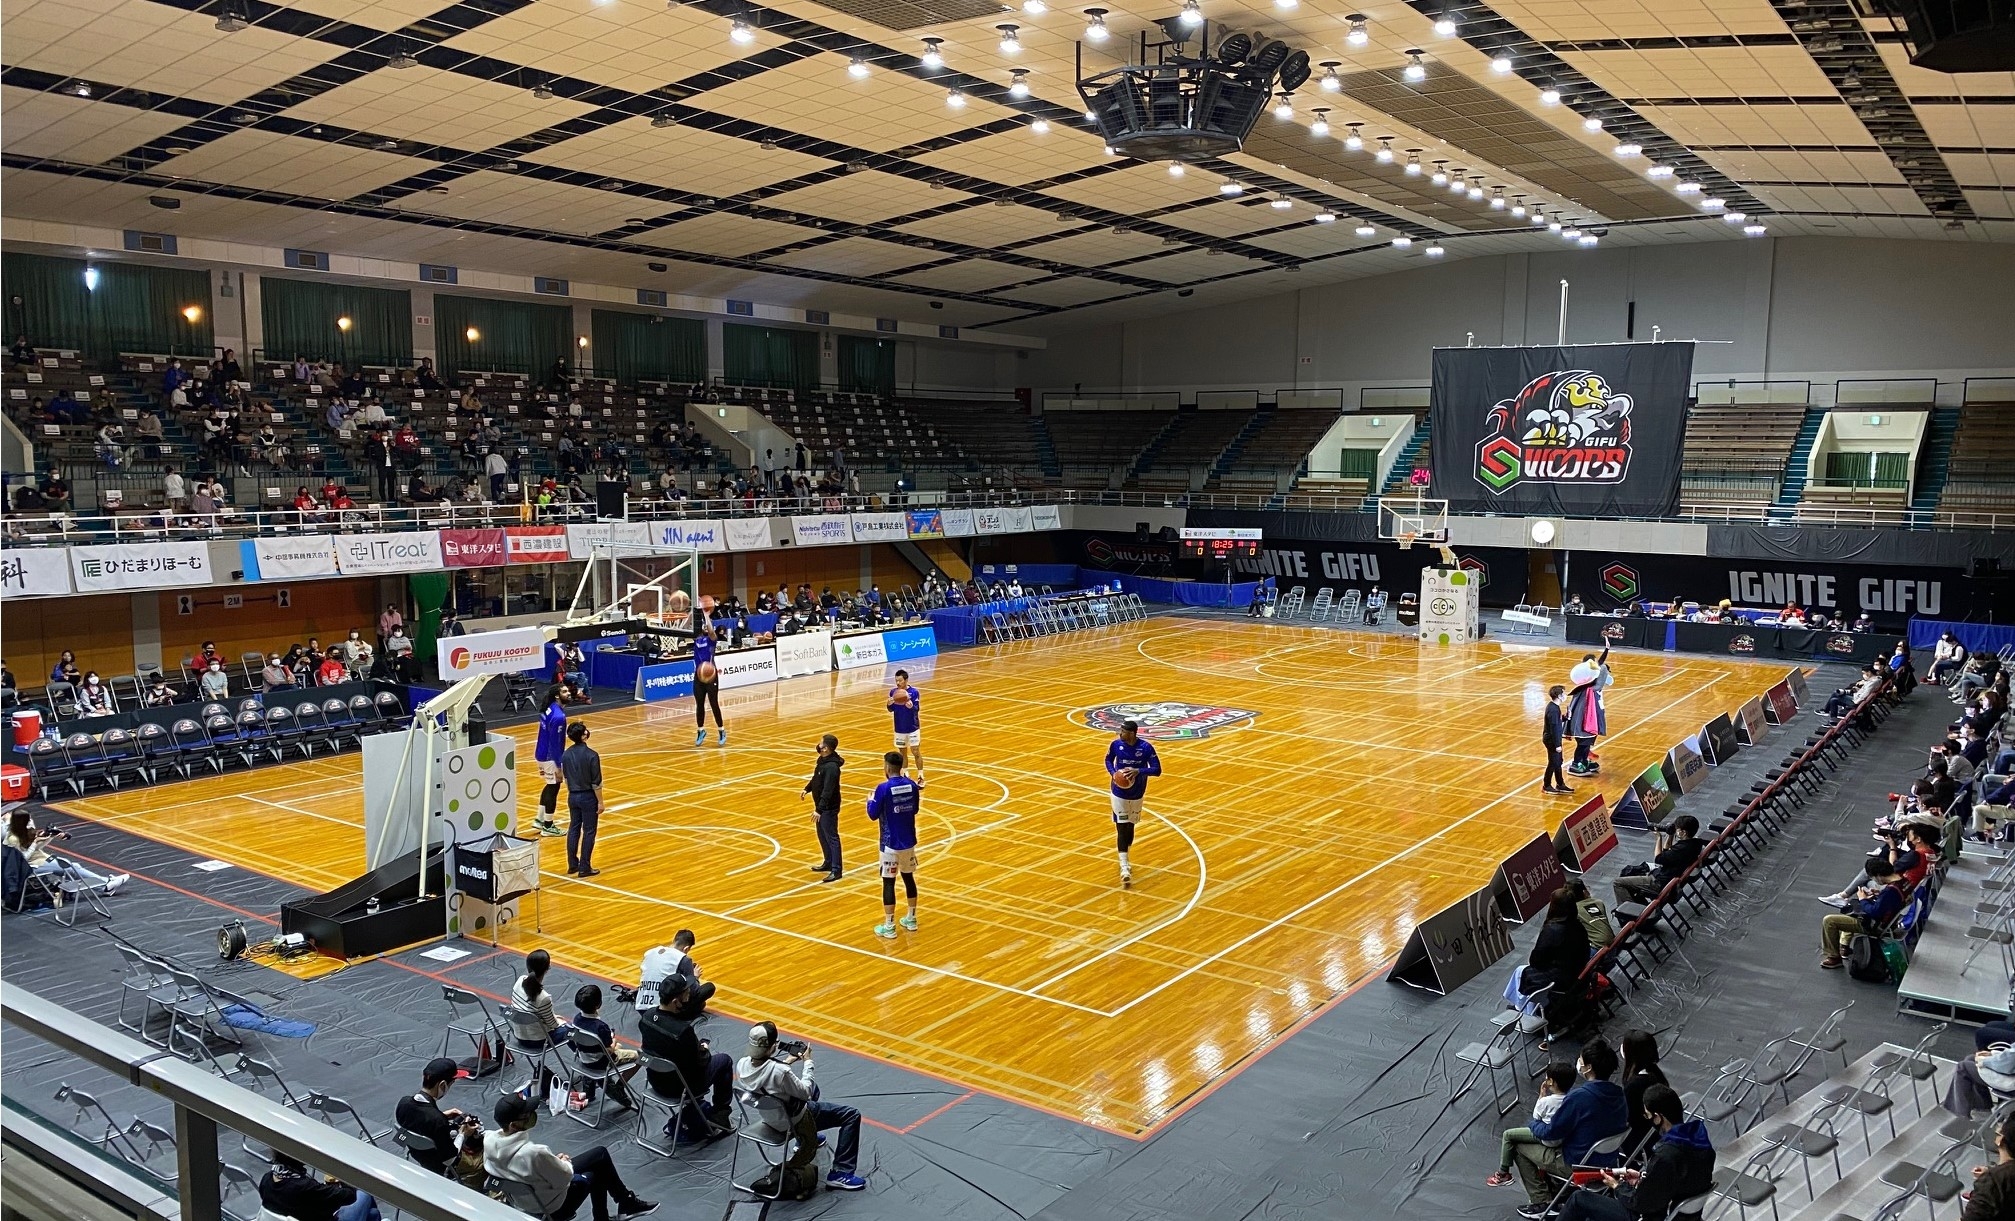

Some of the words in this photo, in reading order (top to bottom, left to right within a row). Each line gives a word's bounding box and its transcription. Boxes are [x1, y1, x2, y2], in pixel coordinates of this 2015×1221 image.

[1584, 436, 1618, 447] GIFU
[1412, 469, 1429, 483] 24
[662, 527, 682, 545] JIN
[822, 529, 846, 538] SPORTS
[461, 543, 502, 555] 東洋スタビ
[523, 538, 563, 550] 西濃建設
[1212, 540, 1233, 549] 18:25
[1197, 547, 1204, 556] 0
[1249, 547, 1256, 556] 0
[105, 556, 202, 574] ひだまりほーむ
[1320, 552, 1381, 581] GIFU
[1728, 571, 1837, 608] IGNITE
[1858, 577, 1942, 615] GIFU
[227, 596, 240, 606] 2M
[900, 637, 931, 651] シーシーアイ
[473, 649, 502, 661] FUKUJU
[504, 646, 530, 657] KOGYO
[793, 646, 828, 662] SoftBank
[856, 648, 883, 660] 新日本ガス
[723, 664, 747, 676] ASAHI
[748, 661, 773, 671] FORGE
[1580, 813, 1610, 847] 西濃建設
[459, 864, 488, 881] molten
[1525, 856, 1559, 893] 東洋スタビ
